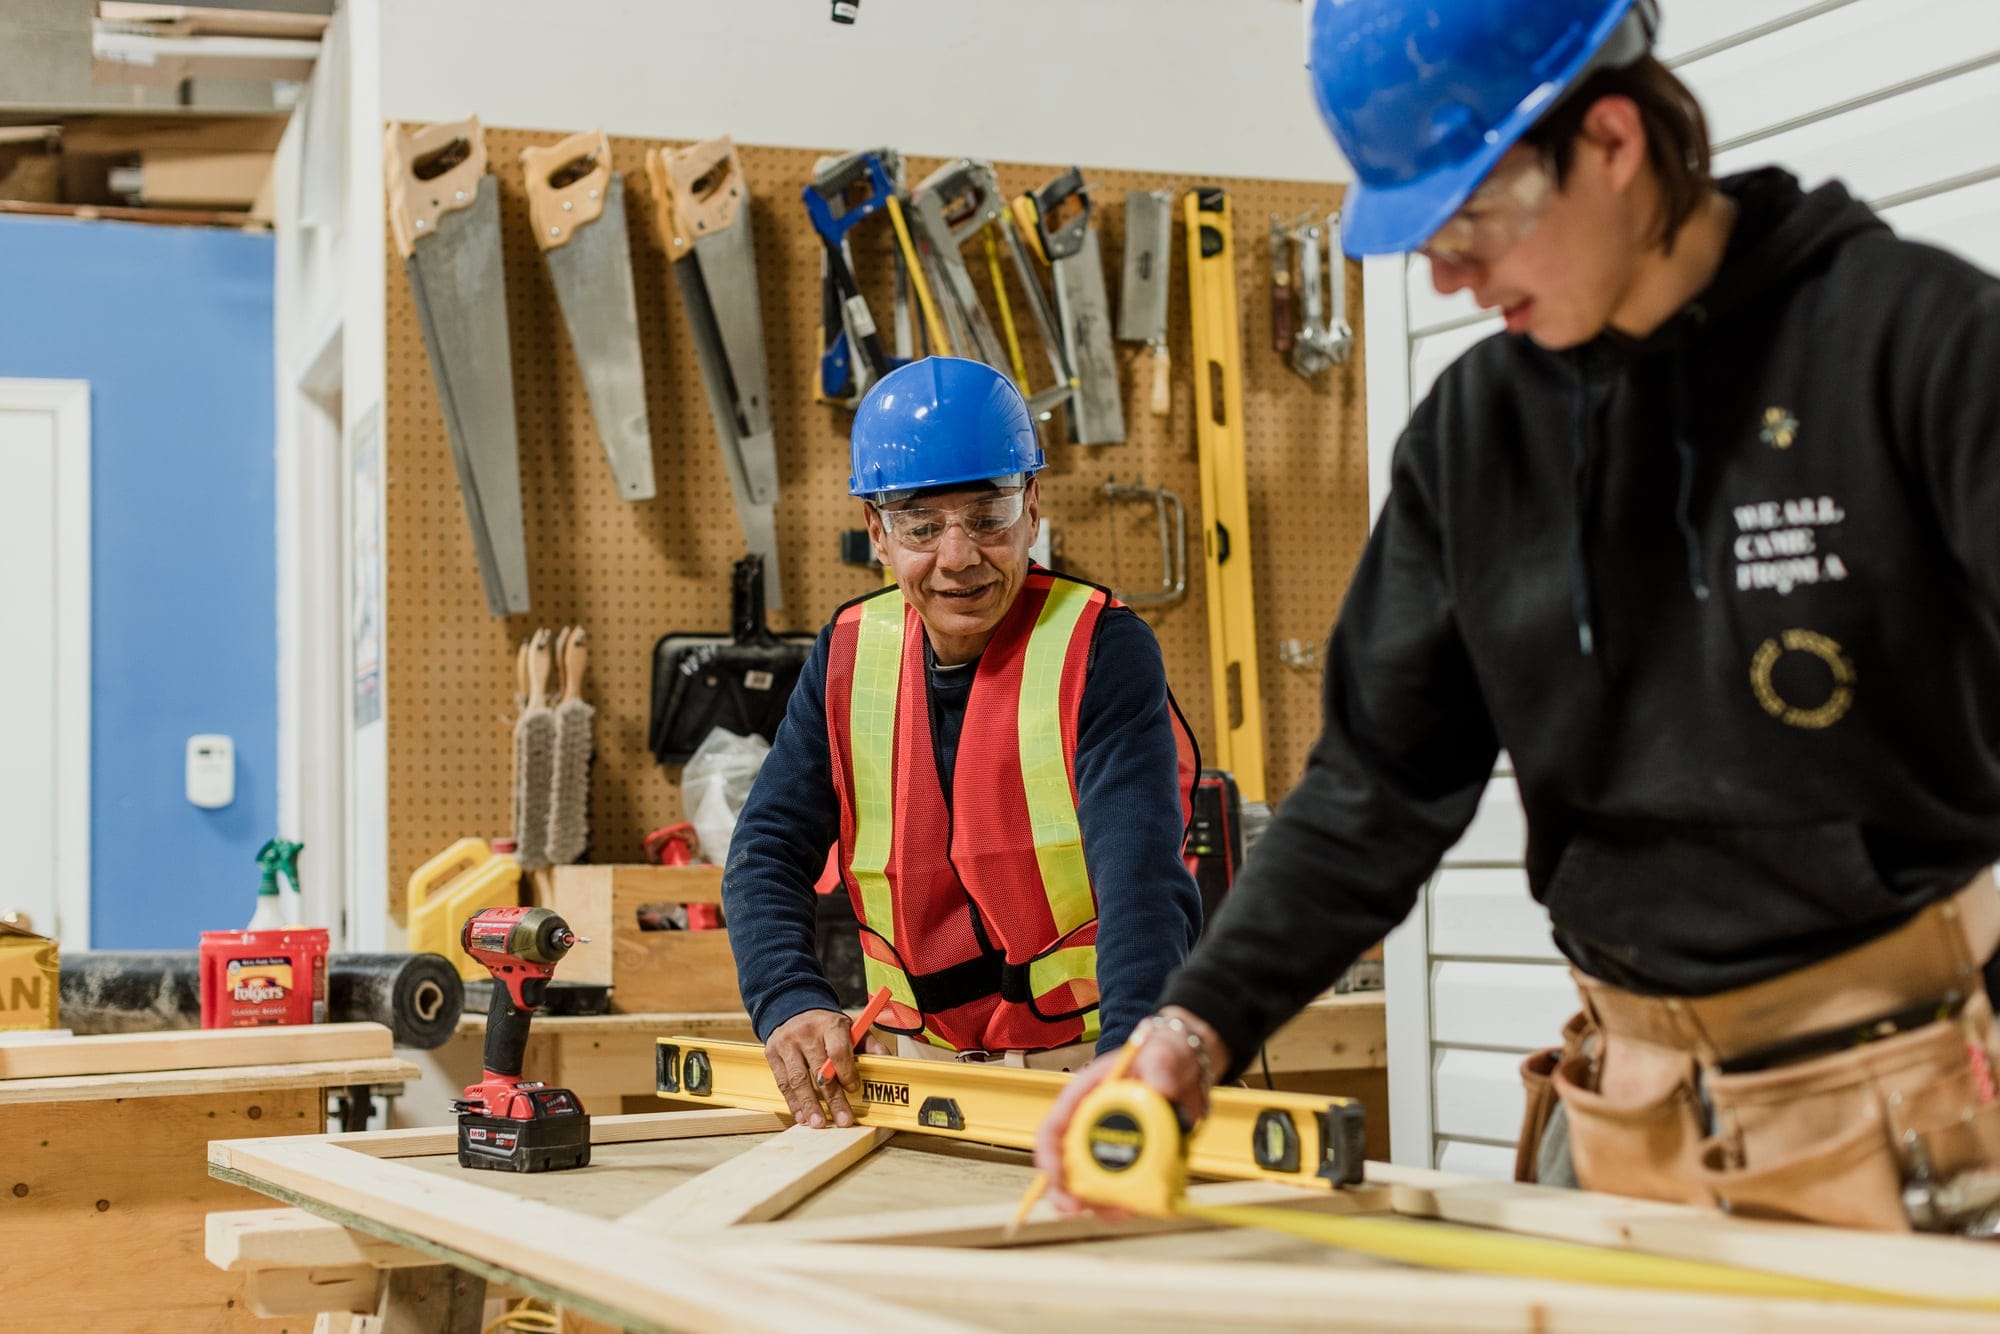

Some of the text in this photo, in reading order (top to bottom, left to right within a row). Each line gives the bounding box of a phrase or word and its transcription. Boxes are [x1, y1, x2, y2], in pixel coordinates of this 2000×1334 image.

[1733, 500, 1782, 531] WE
[1733, 527, 1816, 561] CAME
[0, 976, 41, 1011] N
[233, 983, 284, 1004] Folgers
